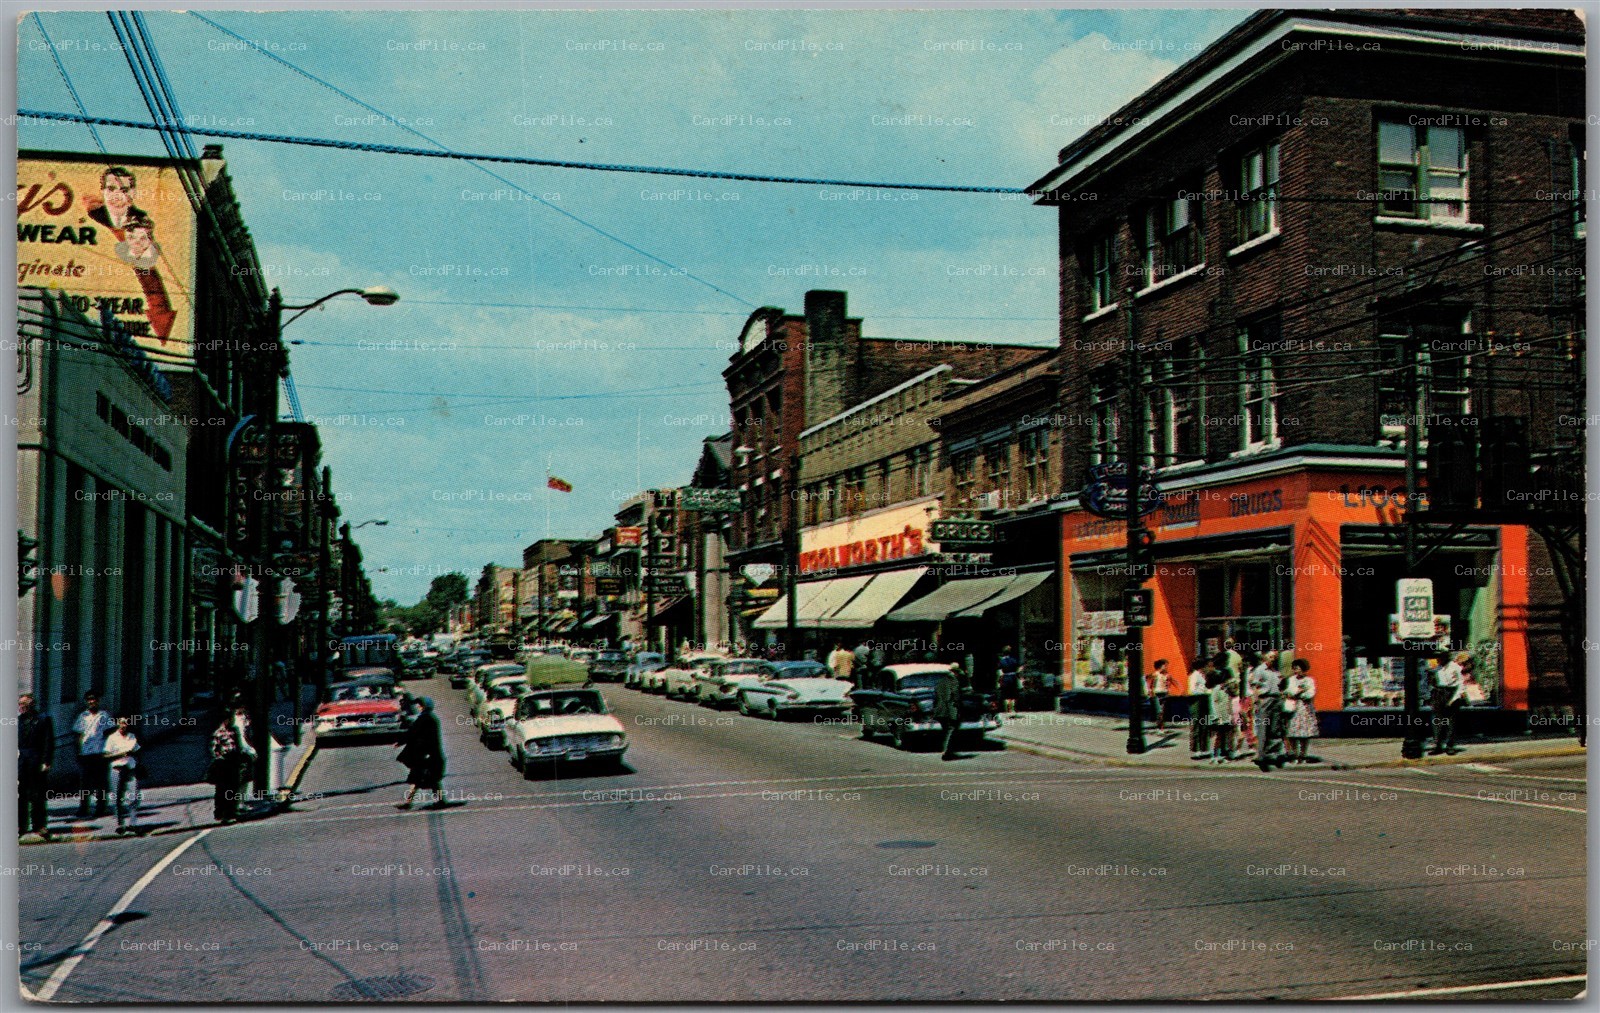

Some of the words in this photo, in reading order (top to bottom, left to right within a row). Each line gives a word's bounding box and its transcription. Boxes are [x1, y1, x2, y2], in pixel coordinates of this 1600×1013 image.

[17, 224, 97, 245] WEAR
[235, 466, 249, 542] LOANS
[1229, 489, 1282, 517] DRUGS
[934, 523, 990, 539] DRUGS
